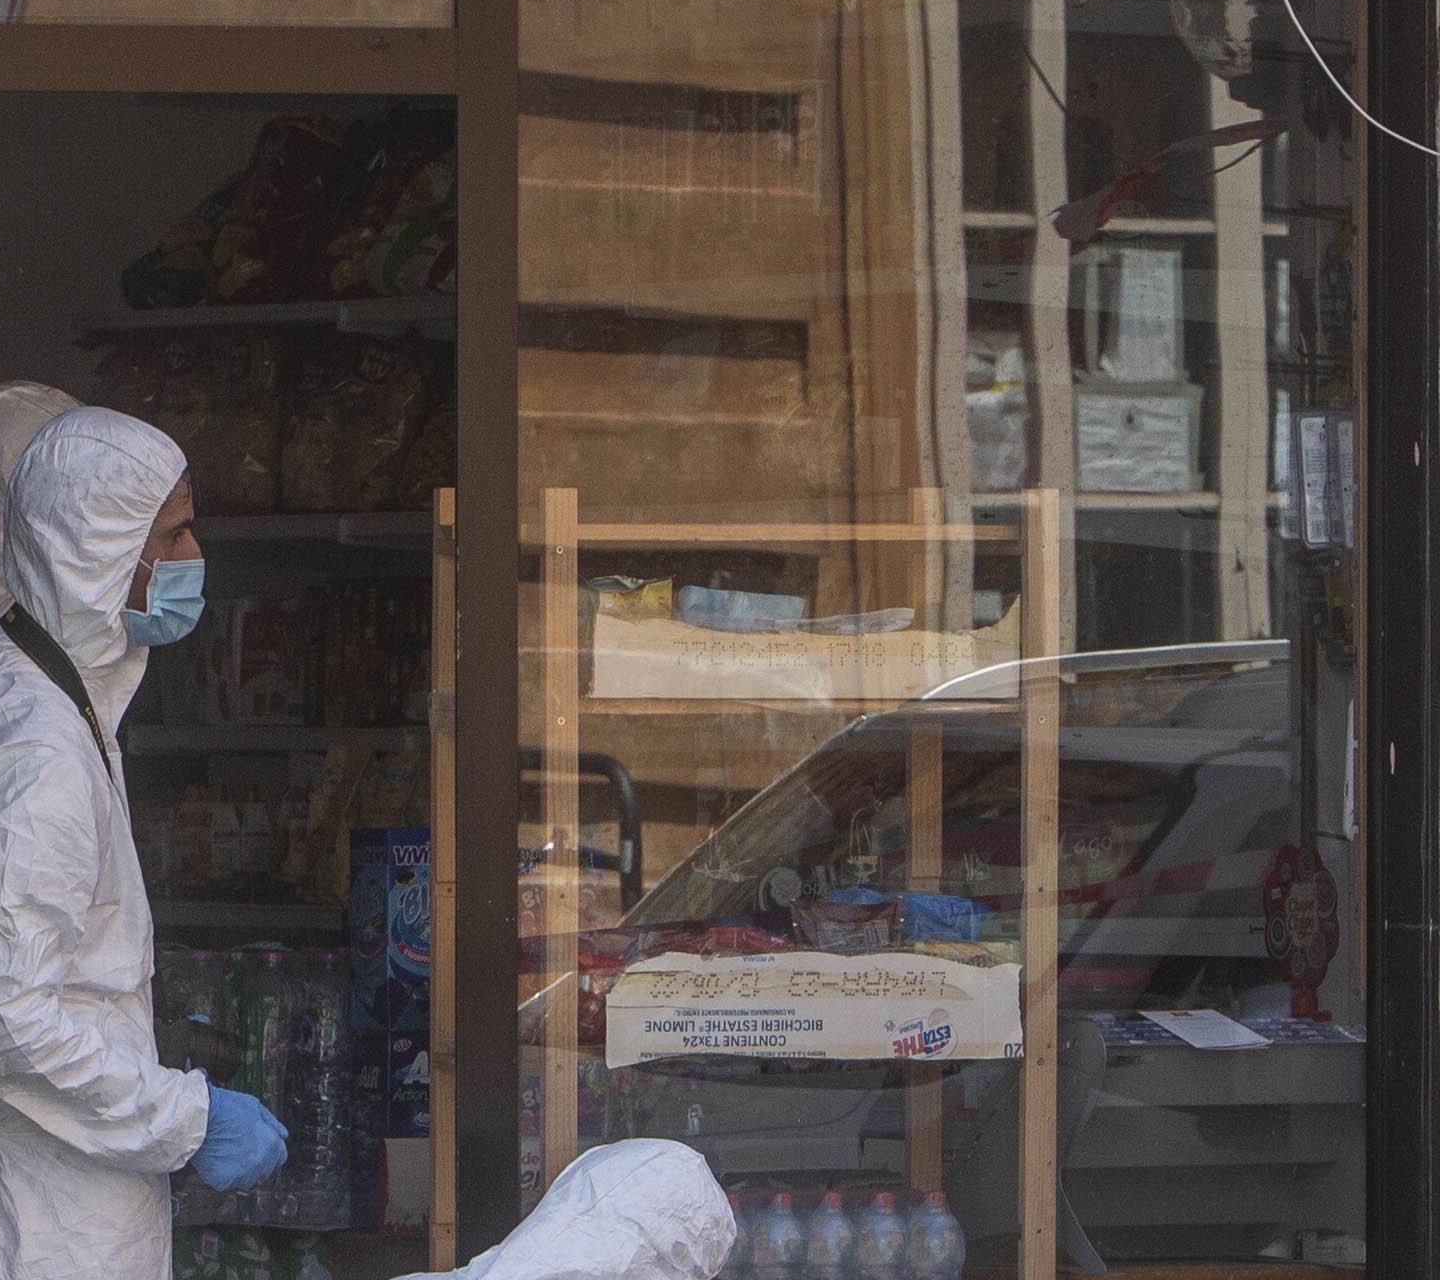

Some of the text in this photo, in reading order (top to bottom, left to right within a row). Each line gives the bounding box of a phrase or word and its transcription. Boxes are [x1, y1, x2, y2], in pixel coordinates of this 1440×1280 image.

[644, 1020, 696, 1033] LIMONE
[761, 1019, 824, 1033] BICCHIERI
[682, 1034, 787, 1048] CONTIENE T3x24
